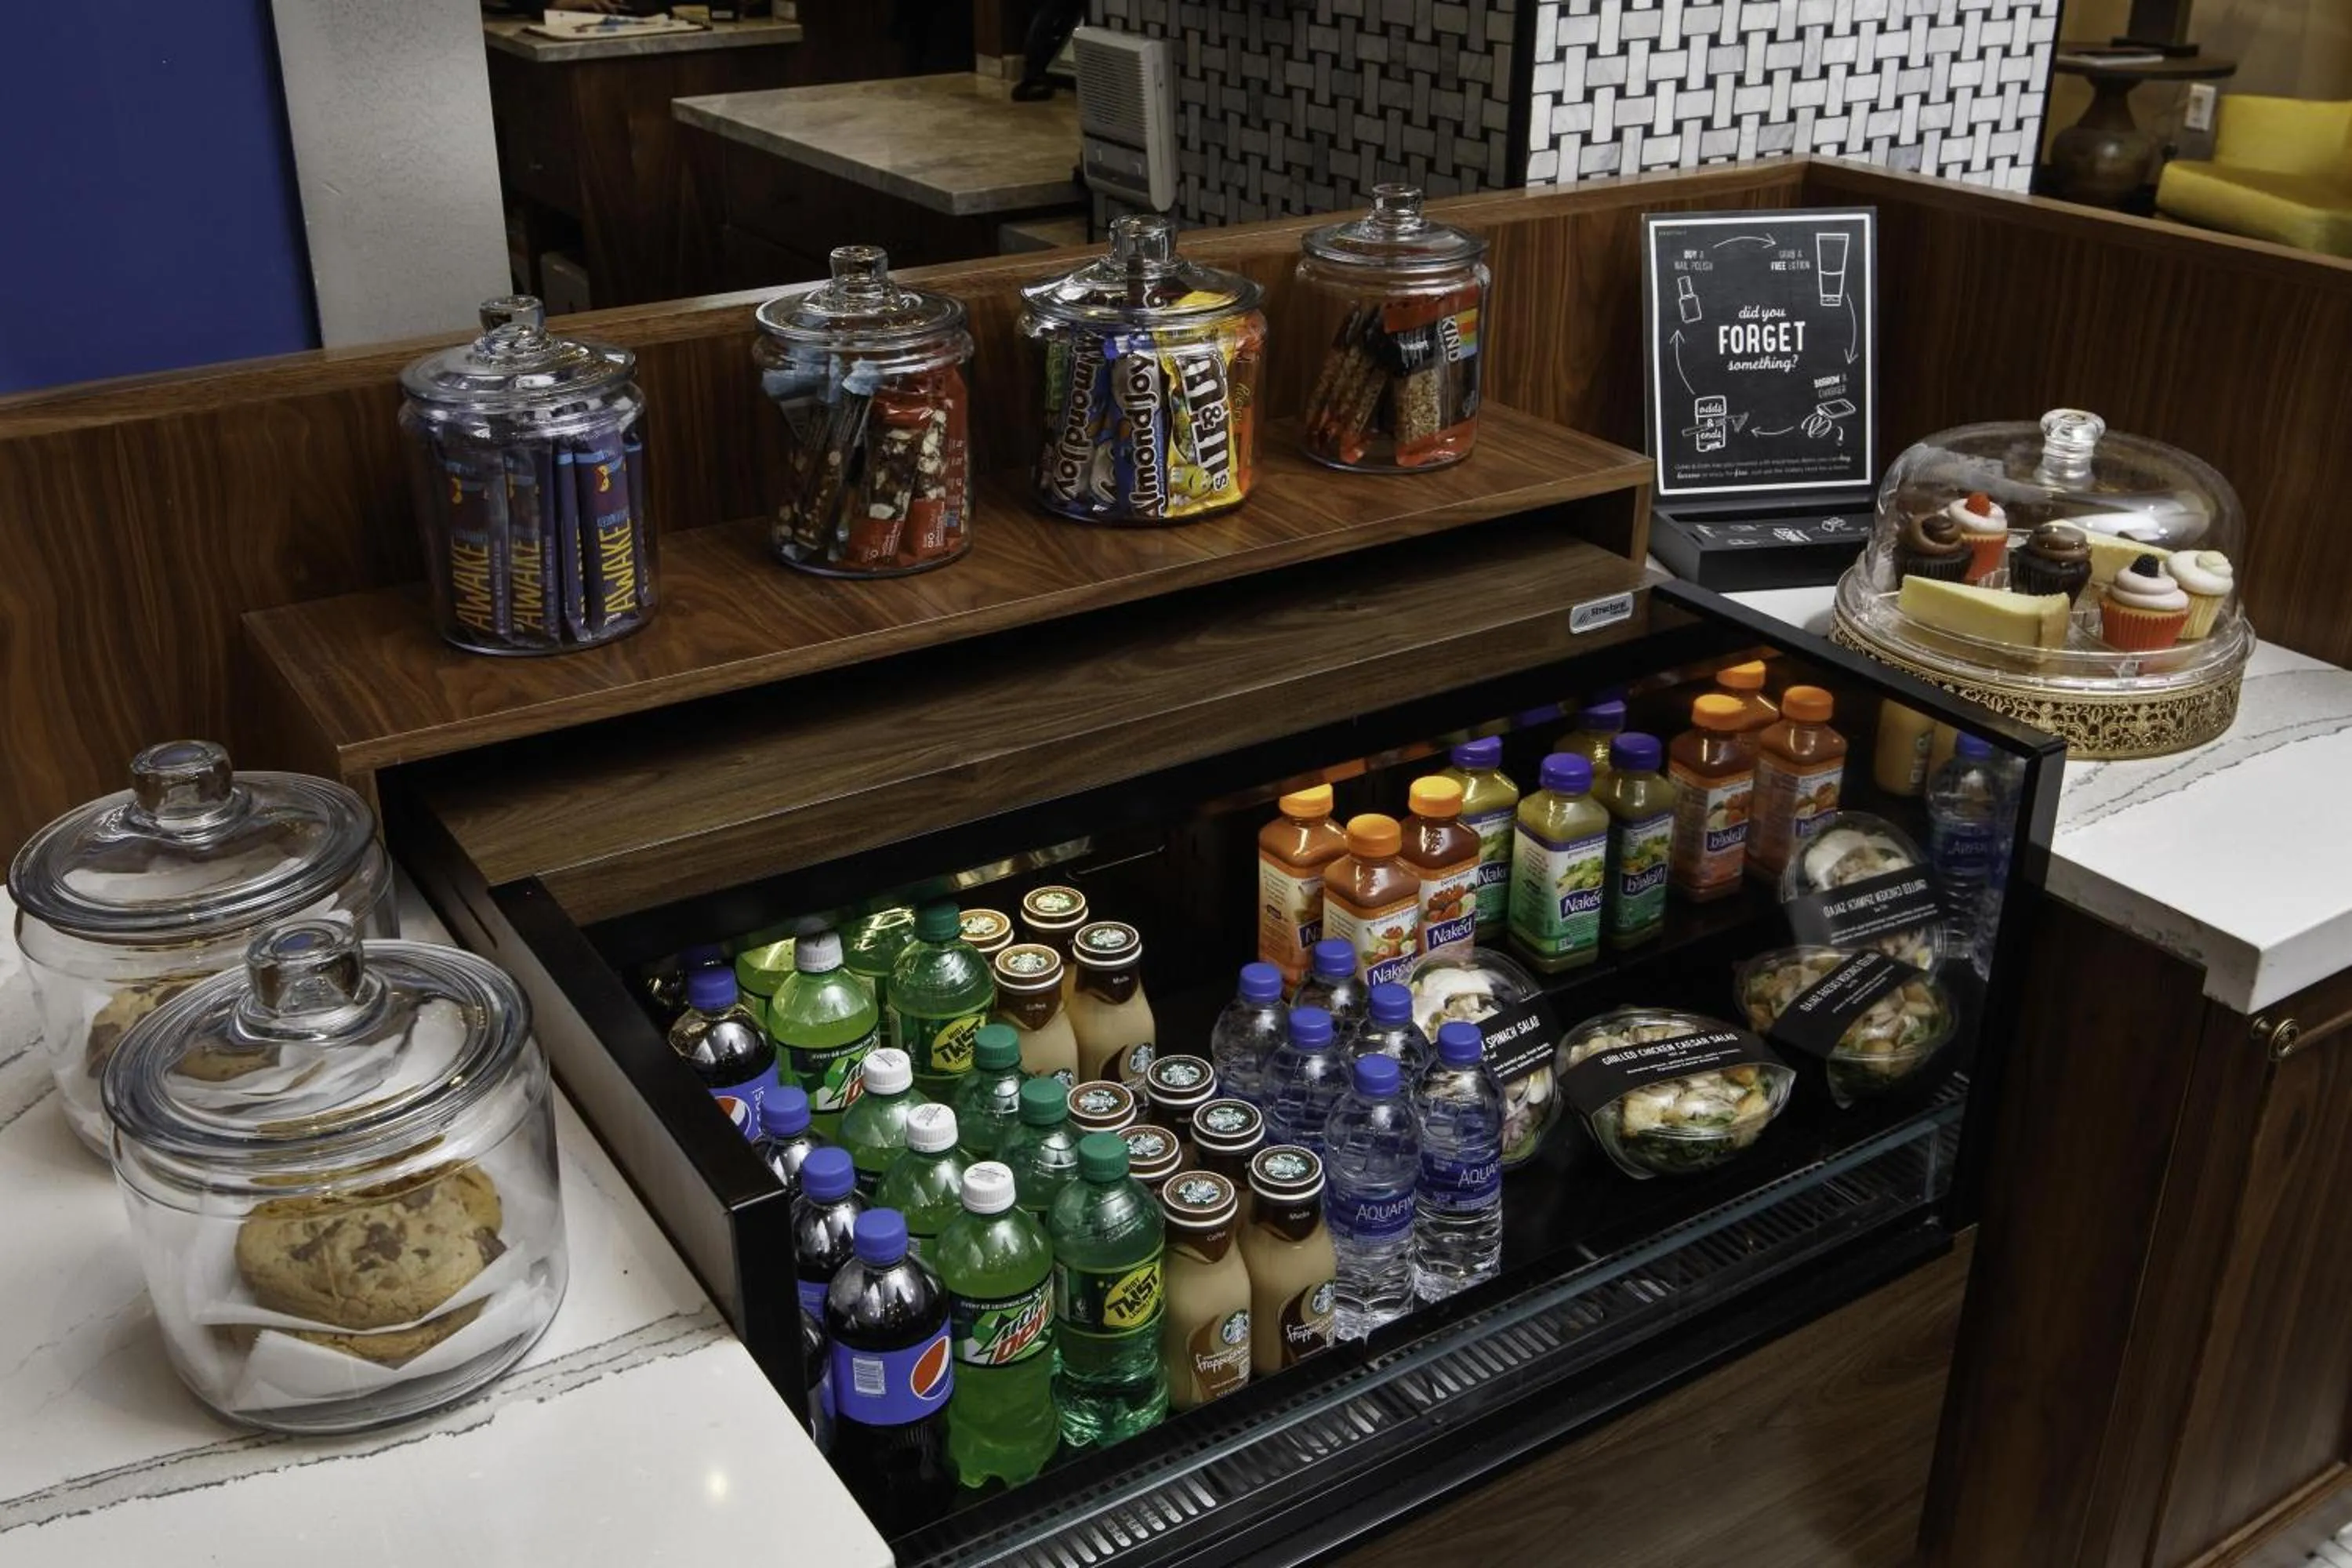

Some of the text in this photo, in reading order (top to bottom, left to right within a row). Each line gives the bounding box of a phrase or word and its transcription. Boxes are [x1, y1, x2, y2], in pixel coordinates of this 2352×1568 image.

[1738, 305, 1786, 321] did you
[1442, 315, 1461, 362] KIND
[1719, 321, 1806, 354] FORGET
[1728, 354, 1799, 372] something?
[1699, 403, 1723, 414] odds
[1123, 353, 1166, 517] Almond Joy
[1700, 430, 1722, 439] ends
[1053, 444, 1094, 500] Joy
[598, 517, 637, 614] AWAKE
[452, 534, 493, 632] AWAKE
[511, 536, 544, 631] AWAKE
[1478, 864, 1506, 887] Nak
[1563, 888, 1605, 913] Naked
[1432, 919, 1473, 944] Naked
[1517, 1014, 1541, 1034] SALAD
[1602, 1050, 1638, 1065] GRILLED
[1638, 1043, 1676, 1056] CHICKEN
[1708, 1033, 1738, 1044] SALAD
